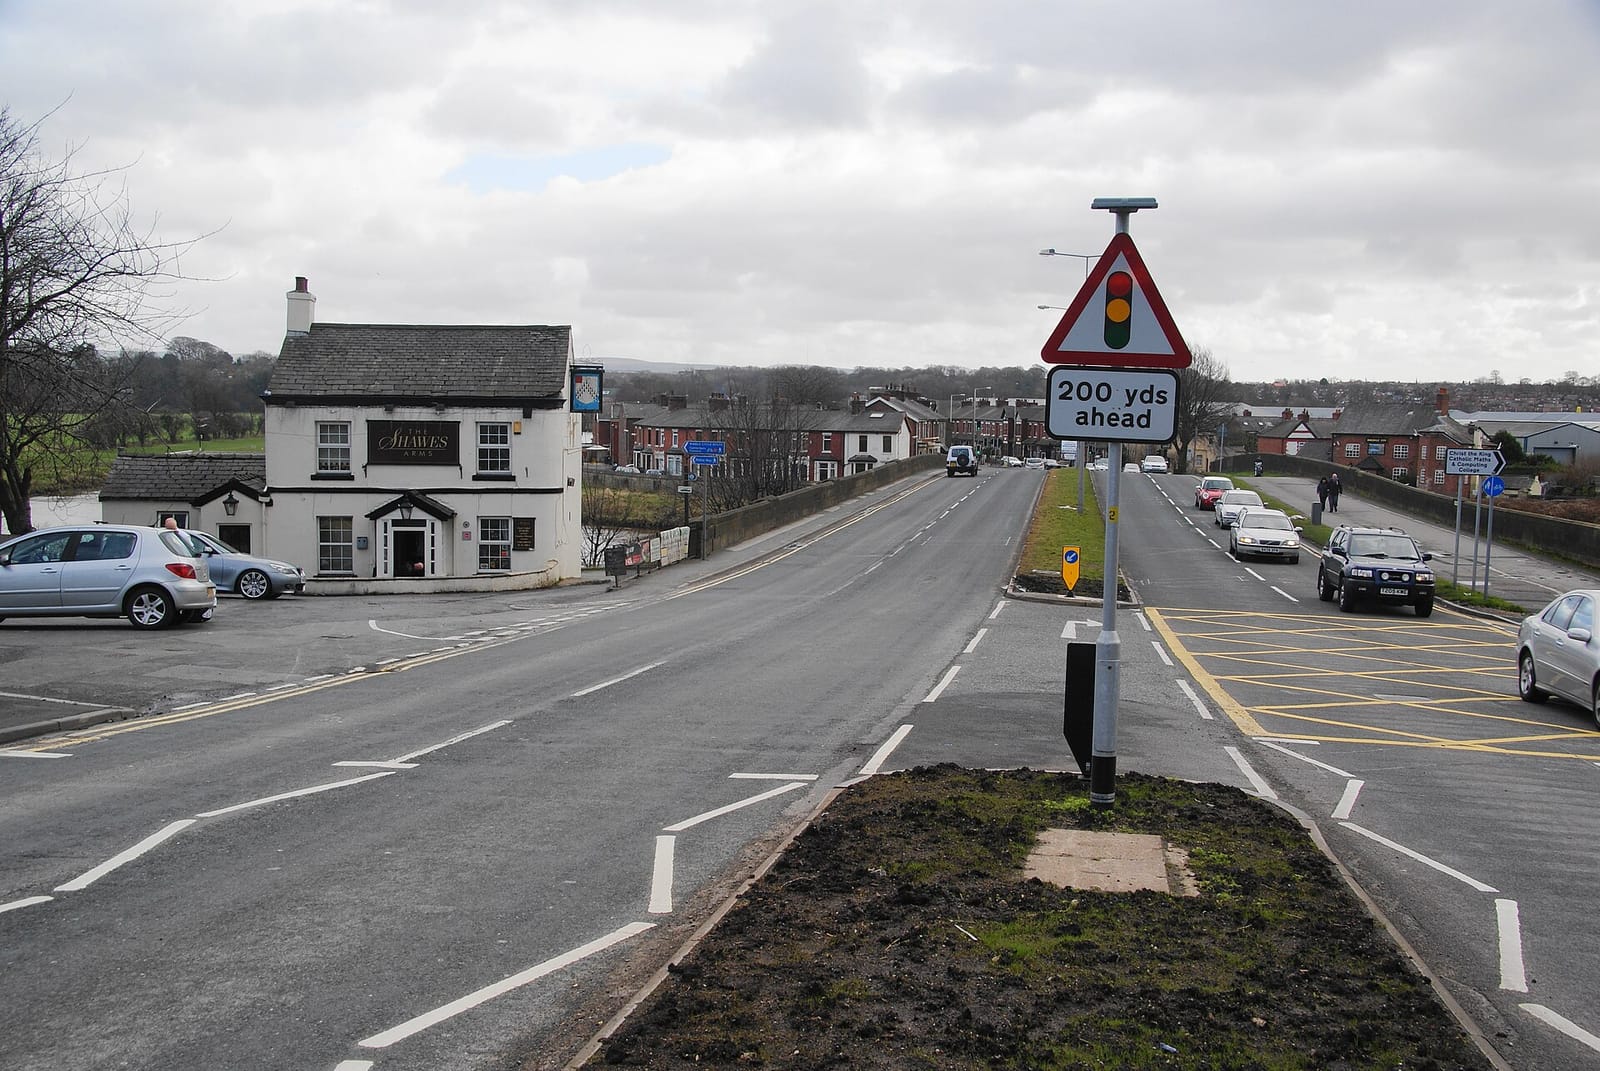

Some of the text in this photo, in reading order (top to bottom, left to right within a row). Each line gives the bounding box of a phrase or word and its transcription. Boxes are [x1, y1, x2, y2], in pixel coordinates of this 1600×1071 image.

[1058, 380, 1168, 407] 200 yds
[1075, 406, 1151, 428] ahead
[1109, 510, 1116, 520] 2
